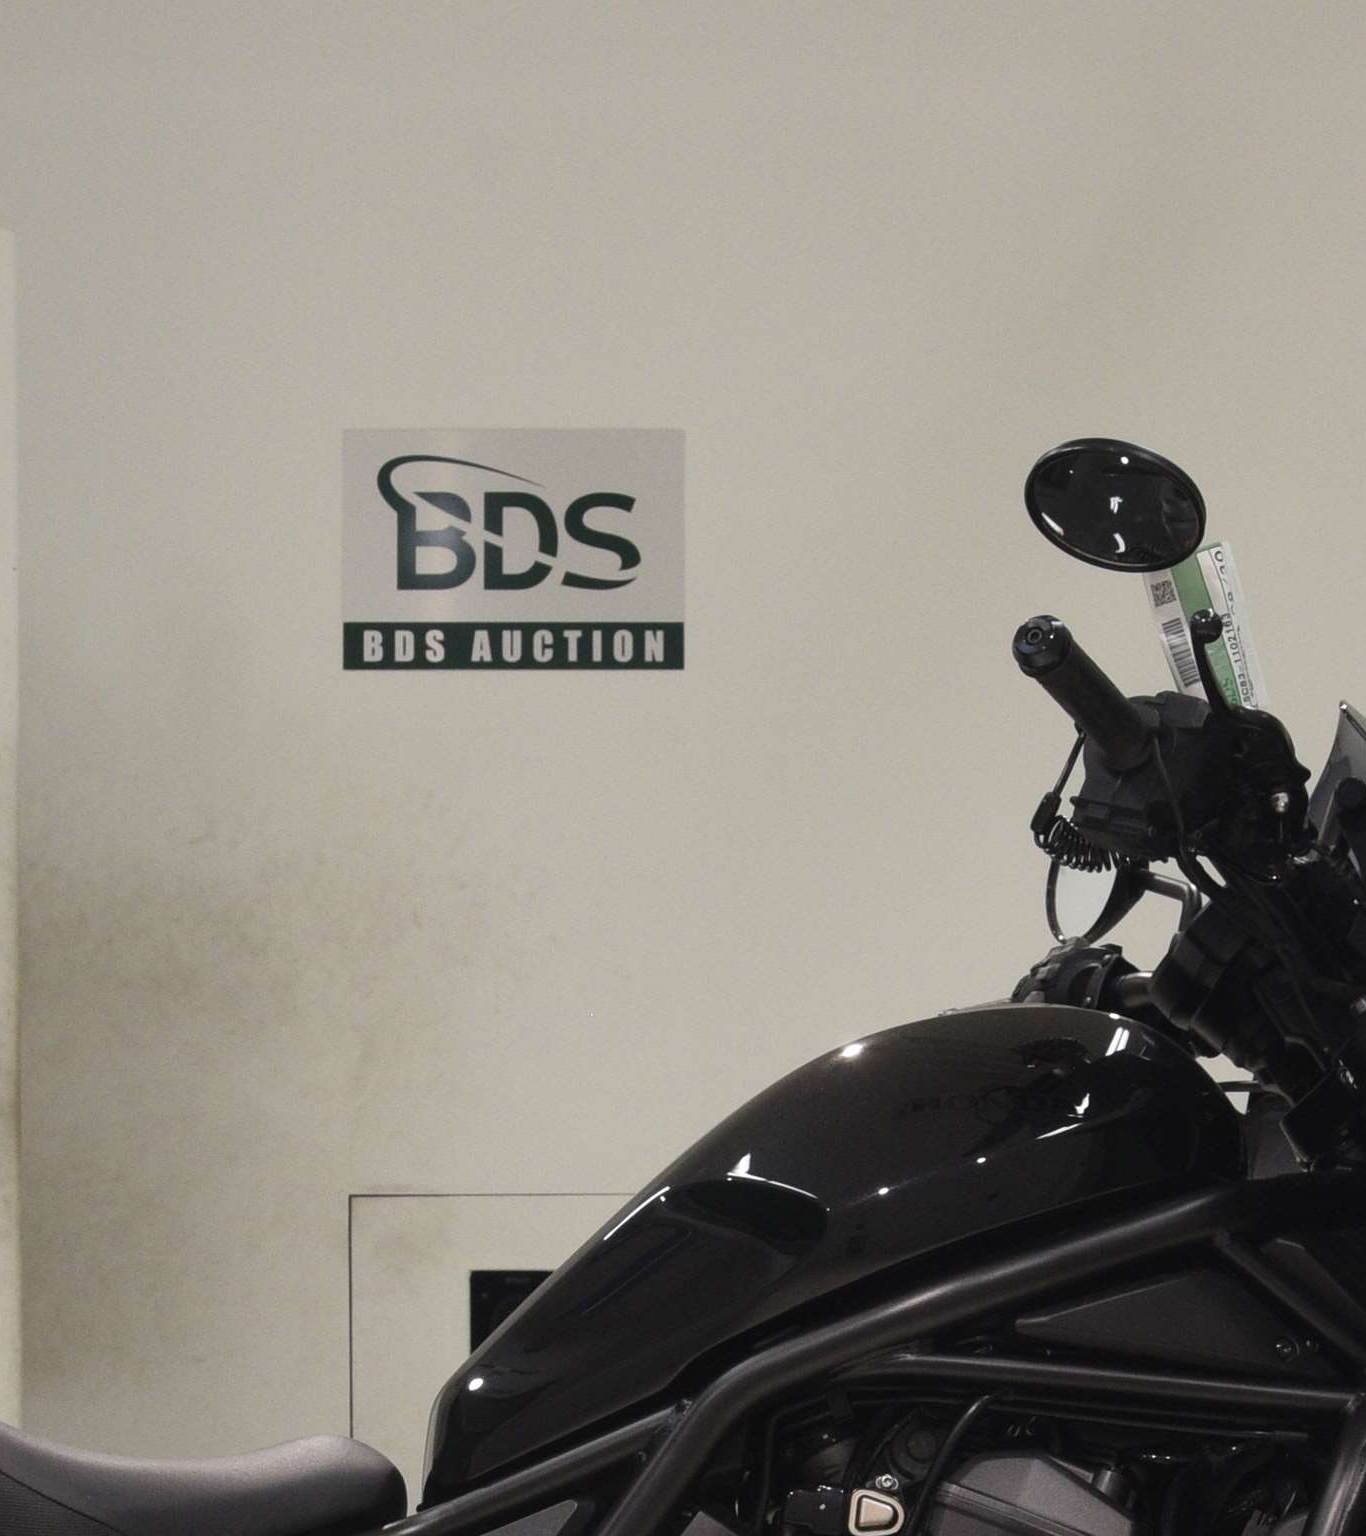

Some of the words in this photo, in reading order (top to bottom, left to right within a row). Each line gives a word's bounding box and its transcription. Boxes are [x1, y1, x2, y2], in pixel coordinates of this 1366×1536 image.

[377, 455, 641, 590] BDS
[363, 630, 445, 663] BDS
[471, 630, 665, 663] AUCTION
